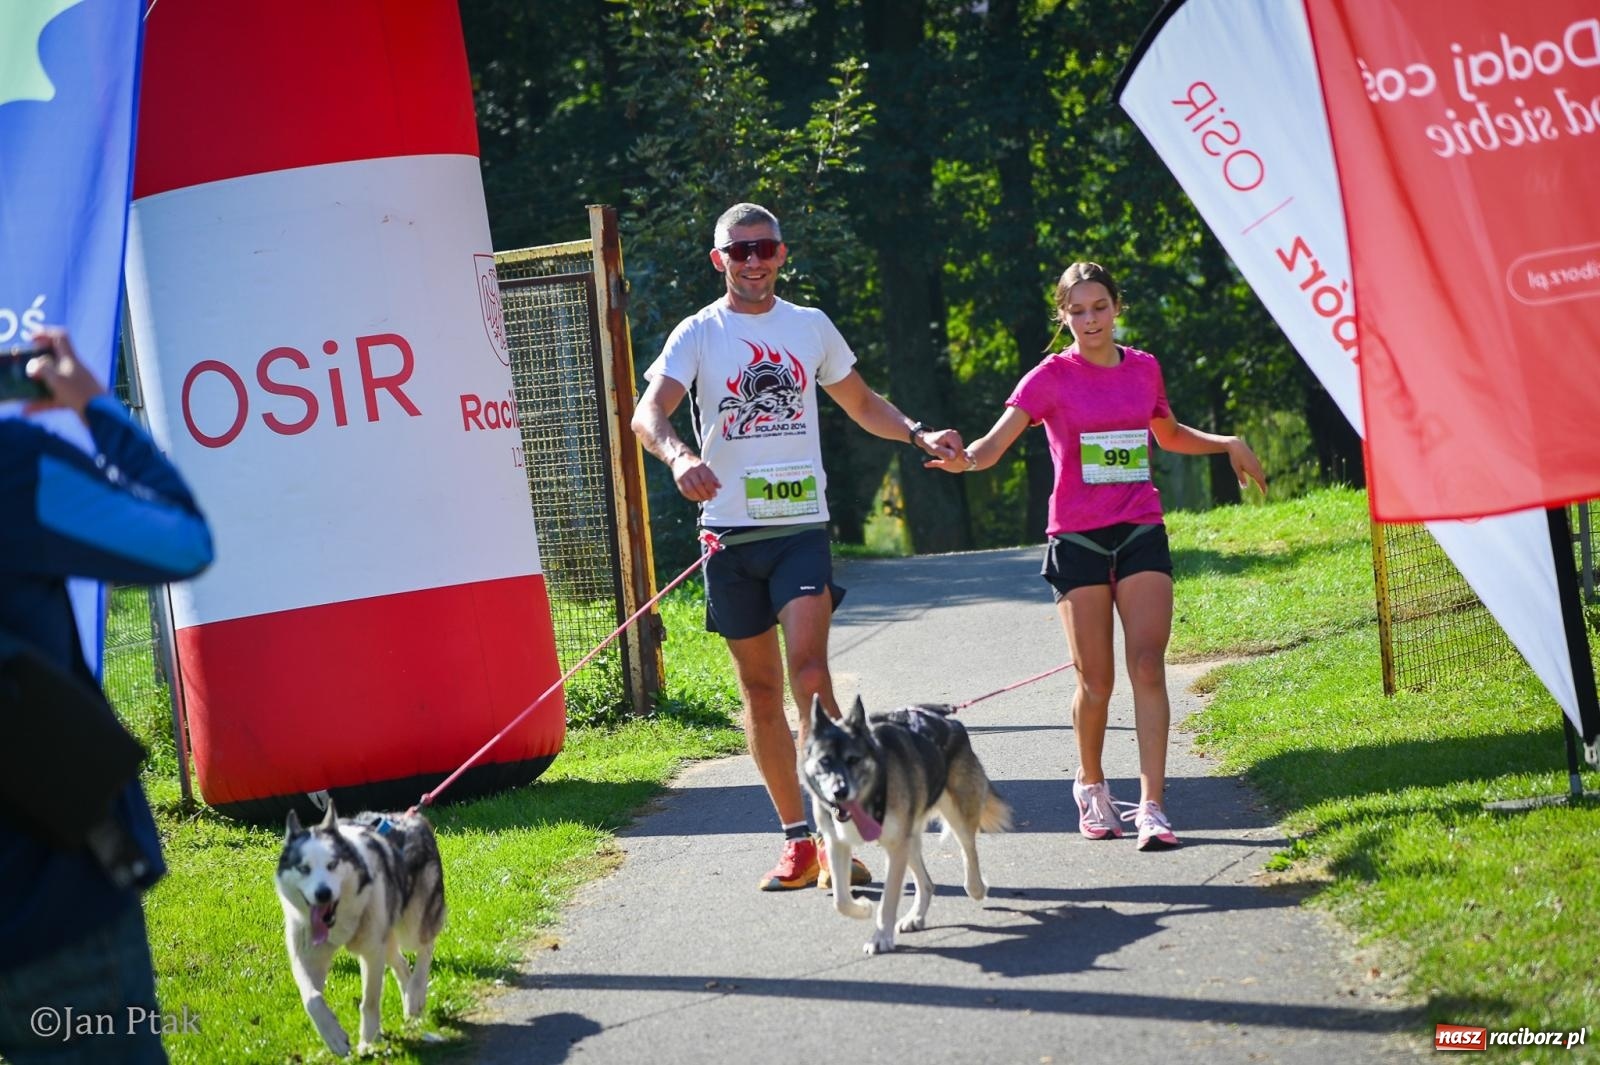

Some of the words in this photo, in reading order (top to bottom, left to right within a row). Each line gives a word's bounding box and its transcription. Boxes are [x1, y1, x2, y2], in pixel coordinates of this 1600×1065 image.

[181, 333, 422, 449] OSiR
[755, 424, 789, 432] POLAND
[1104, 449, 1130, 466] 99
[763, 481, 802, 500] 100
